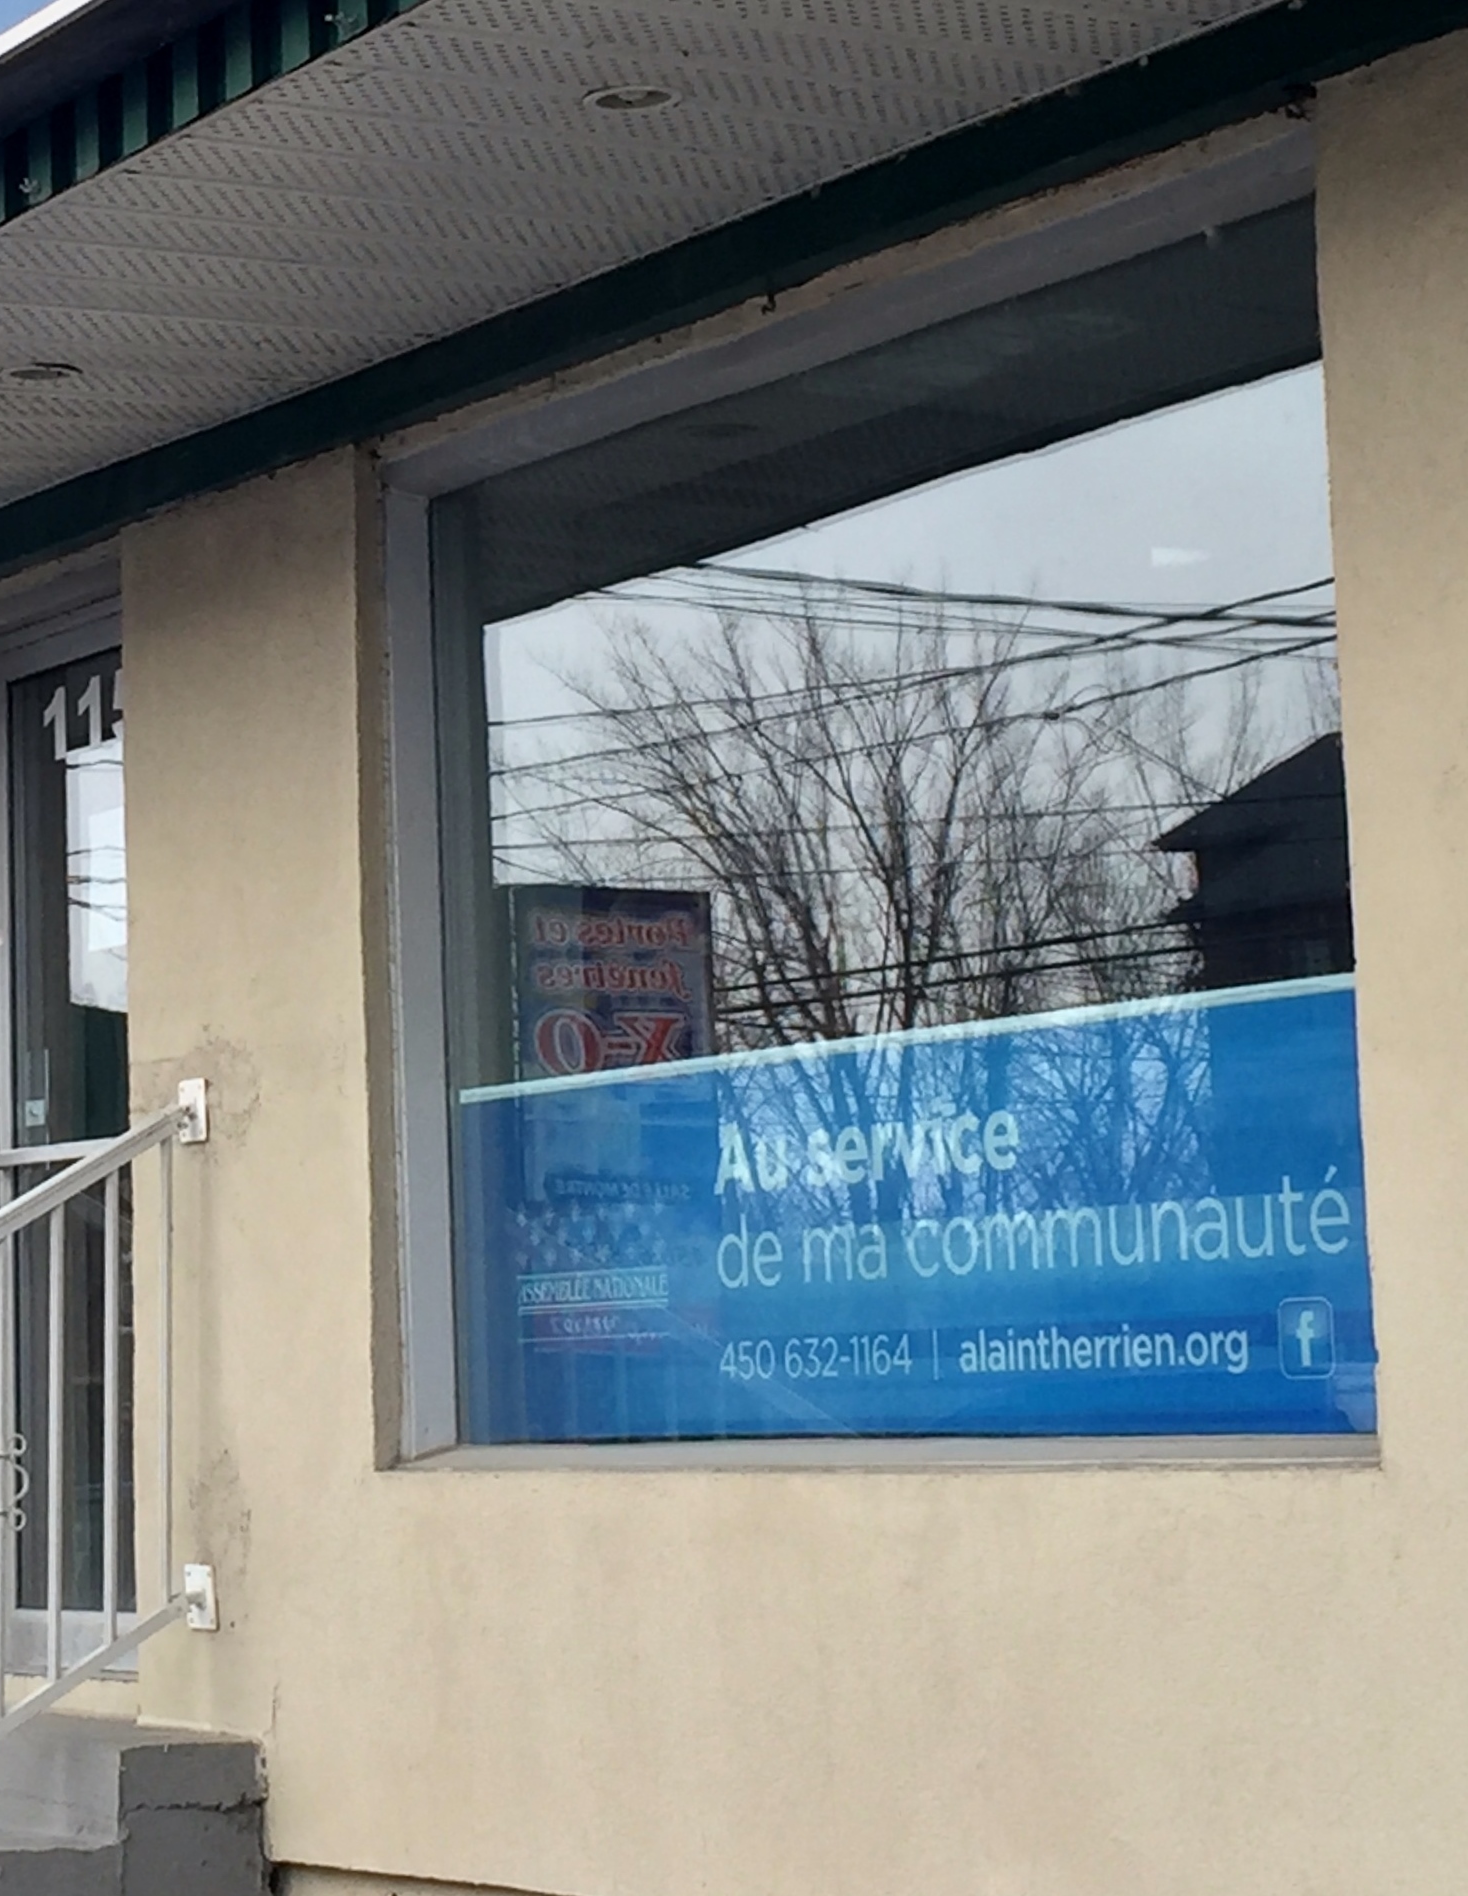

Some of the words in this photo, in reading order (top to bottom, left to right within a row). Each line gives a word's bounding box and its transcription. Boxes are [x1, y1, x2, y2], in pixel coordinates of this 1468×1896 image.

[713, 1119, 789, 1195] Au
[800, 1103, 1020, 1188] service
[716, 1213, 783, 1289] de
[802, 1221, 887, 1283] ma
[906, 1164, 1352, 1279] communauté
[719, 1339, 776, 1381] 450
[784, 1332, 913, 1378] 632-1164
[958, 1323, 1249, 1374] alaintherrien.org
